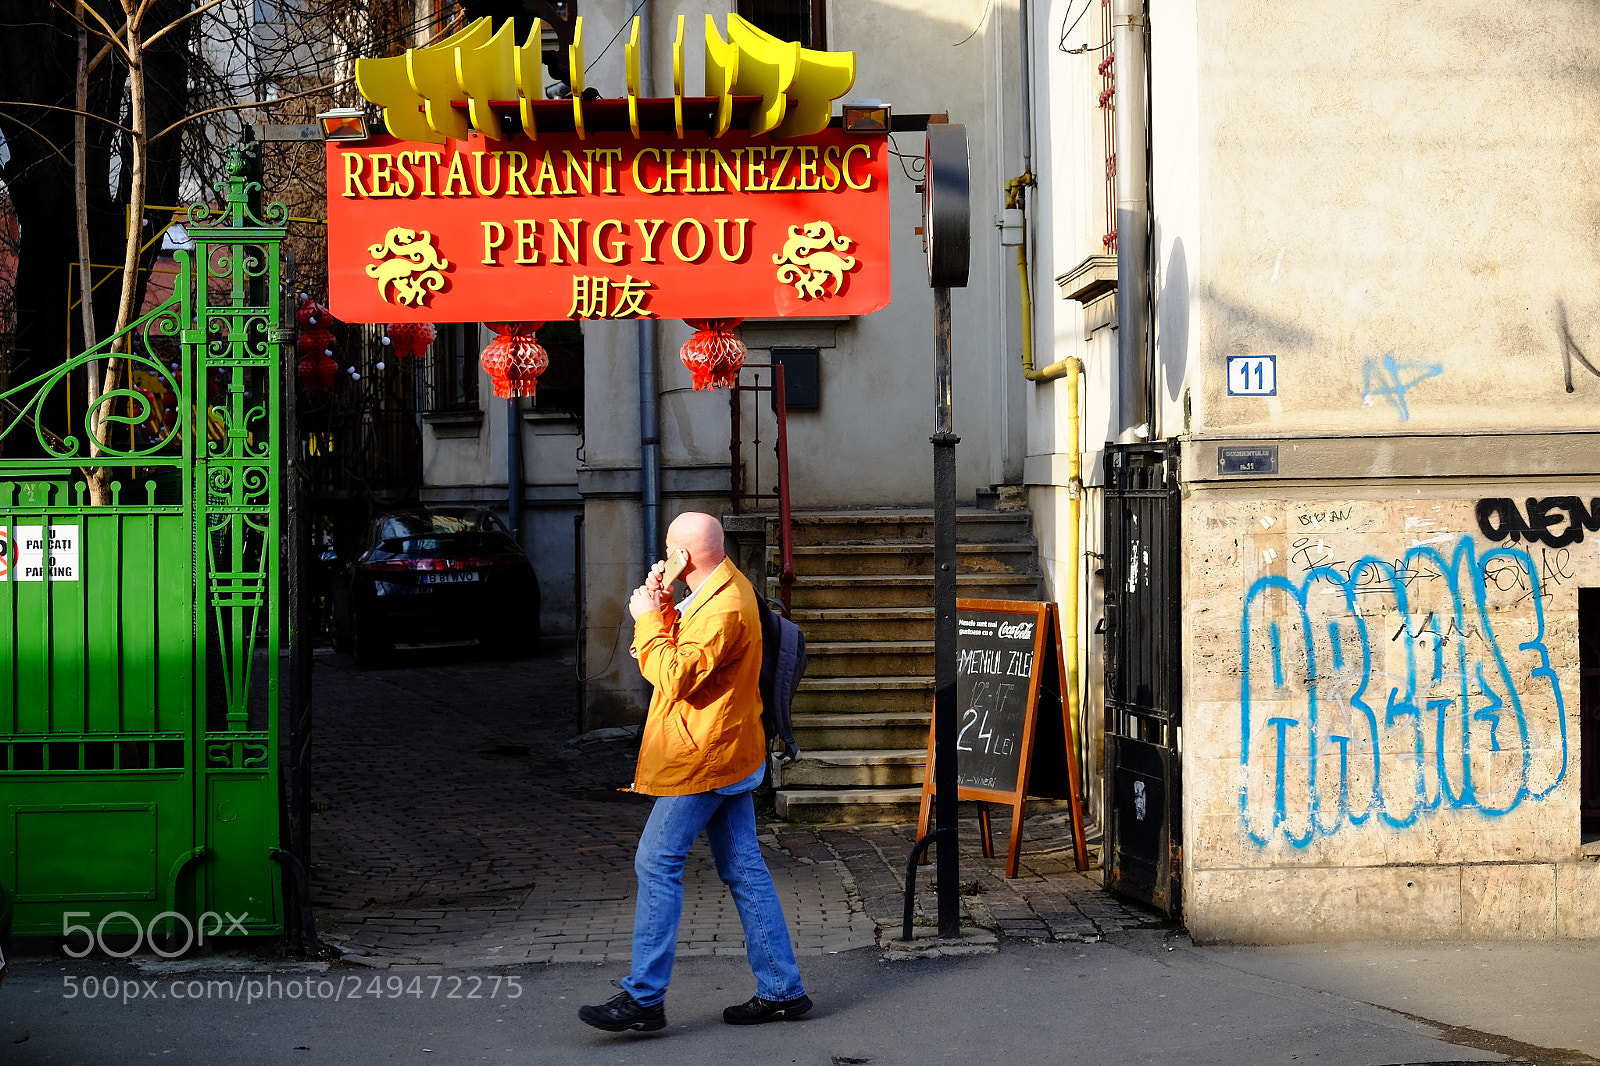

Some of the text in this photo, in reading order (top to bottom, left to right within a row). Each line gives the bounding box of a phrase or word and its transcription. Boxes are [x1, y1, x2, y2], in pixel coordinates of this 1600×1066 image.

[341, 143, 872, 198] RESTAURANT CHINEZESC
[480, 217, 750, 265] PENGYOU
[567, 274, 652, 318] 朋友
[1240, 361, 1264, 390] 11
[429, 574, 436, 583] B
[957, 708, 993, 755] 24
